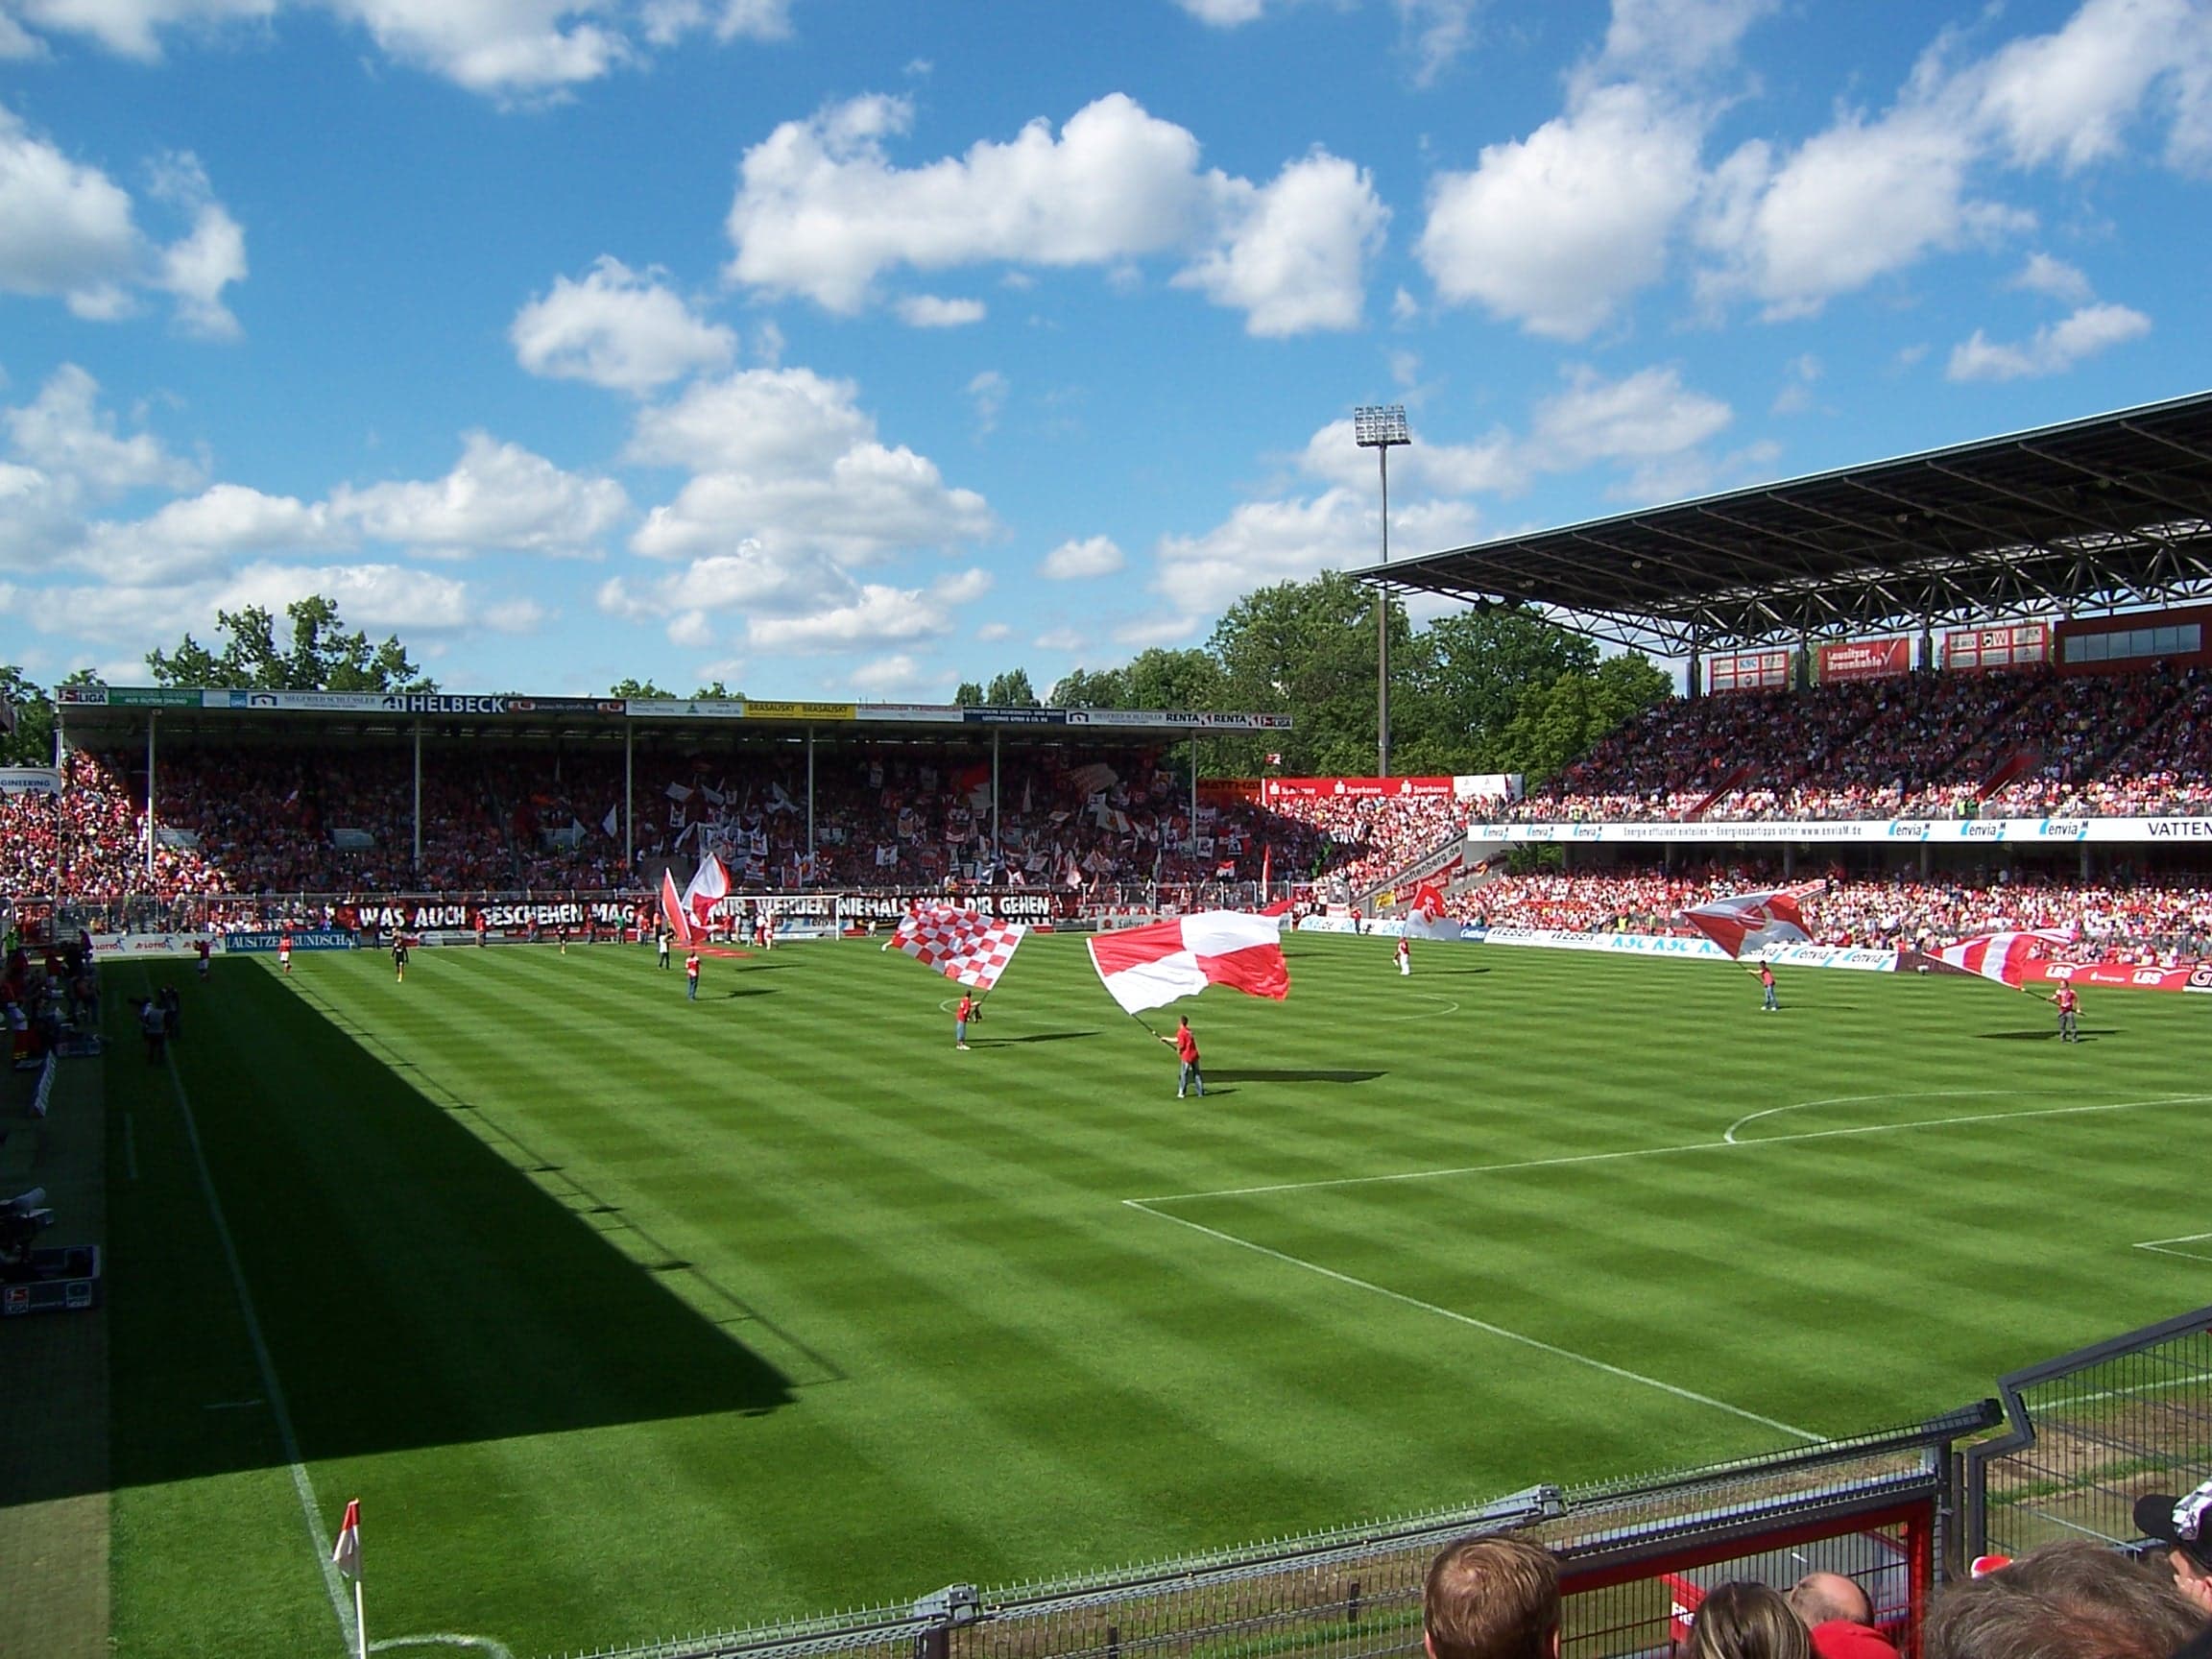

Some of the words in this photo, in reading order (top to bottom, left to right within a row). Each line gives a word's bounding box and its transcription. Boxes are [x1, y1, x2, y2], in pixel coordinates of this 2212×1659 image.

[1827, 647, 1870, 661] Lausitzer
[1827, 655, 1883, 671] Braunkohle
[78, 693, 106, 703] LIGA
[410, 696, 505, 713] HELBECK
[1166, 712, 1200, 724] RENTA
[1214, 714, 1247, 726] RENTA
[1347, 785, 1382, 795] Sparkasse
[1413, 784, 1450, 794] Sparkasse
[1778, 826, 1798, 836] unter
[2148, 822, 2212, 836] VATTEN
[712, 898, 747, 916] WIR
[756, 898, 830, 916] WERDEN
[837, 896, 911, 918] NIEMALS
[964, 896, 994, 915] DIR
[999, 895, 1049, 916] GEHEN
[358, 906, 405, 927] WAS
[413, 905, 466, 928] AUCH
[481, 903, 584, 926] GESCHEHEN
[591, 902, 635, 924] MAG
[227, 934, 283, 949] LAUSITZE
[2045, 966, 2074, 978] LBS
[2132, 972, 2163, 985] LBS
